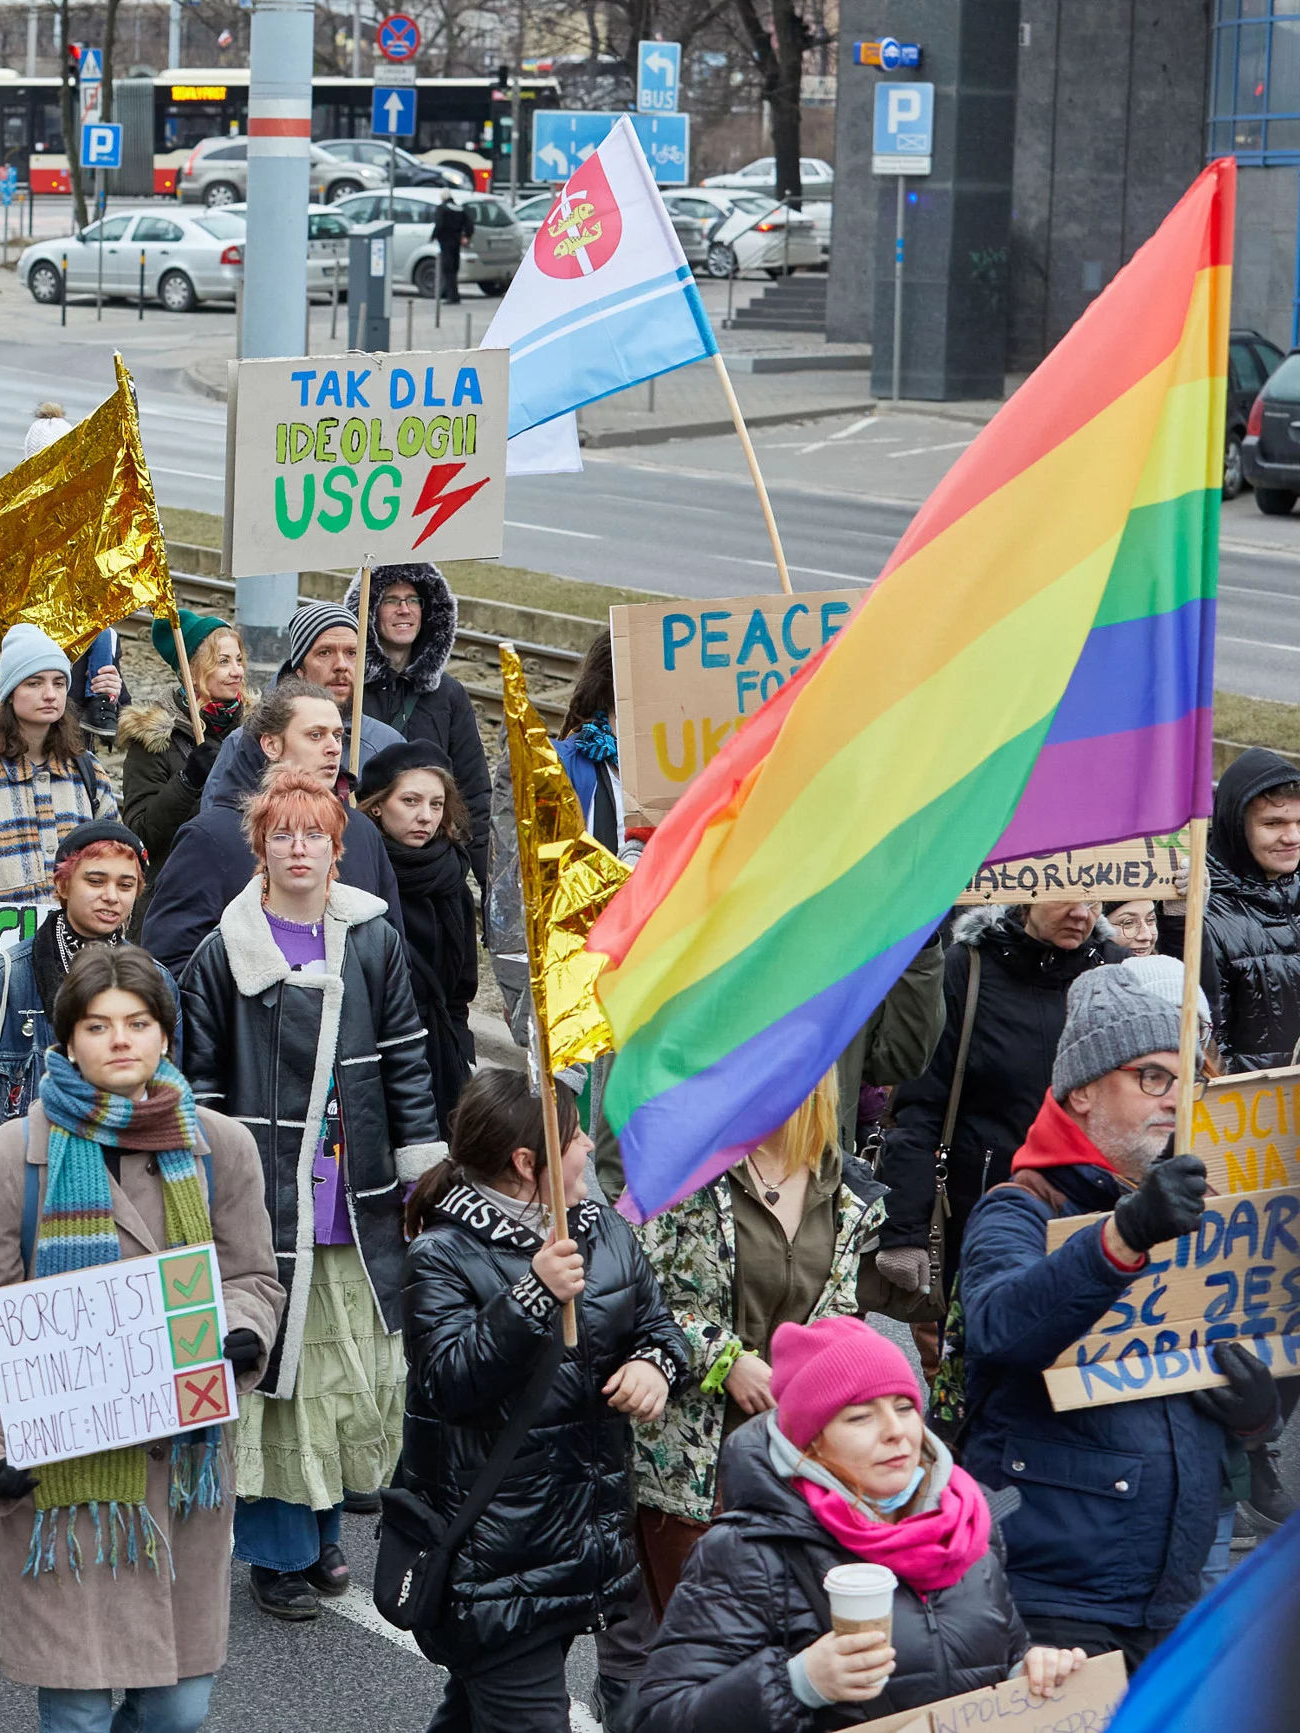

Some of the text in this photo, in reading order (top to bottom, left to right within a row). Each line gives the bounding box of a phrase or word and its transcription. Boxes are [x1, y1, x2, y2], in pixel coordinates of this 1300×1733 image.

[641, 89, 675, 110] BUS
[887, 89, 922, 134] P
[89, 128, 114, 163] P
[291, 366, 483, 409] TAK DLA
[275, 414, 477, 464] IDEOLOGII
[275, 465, 402, 540] USG
[662, 601, 851, 671] PEACE
[736, 666, 801, 714] FO
[653, 716, 750, 783] UK
[97, 1271, 156, 1336] JEST
[1, 1326, 165, 1404] FEMINIZM: JEST
[92, 1398, 130, 1444] NIE
[131, 1383, 177, 1436] MA!
